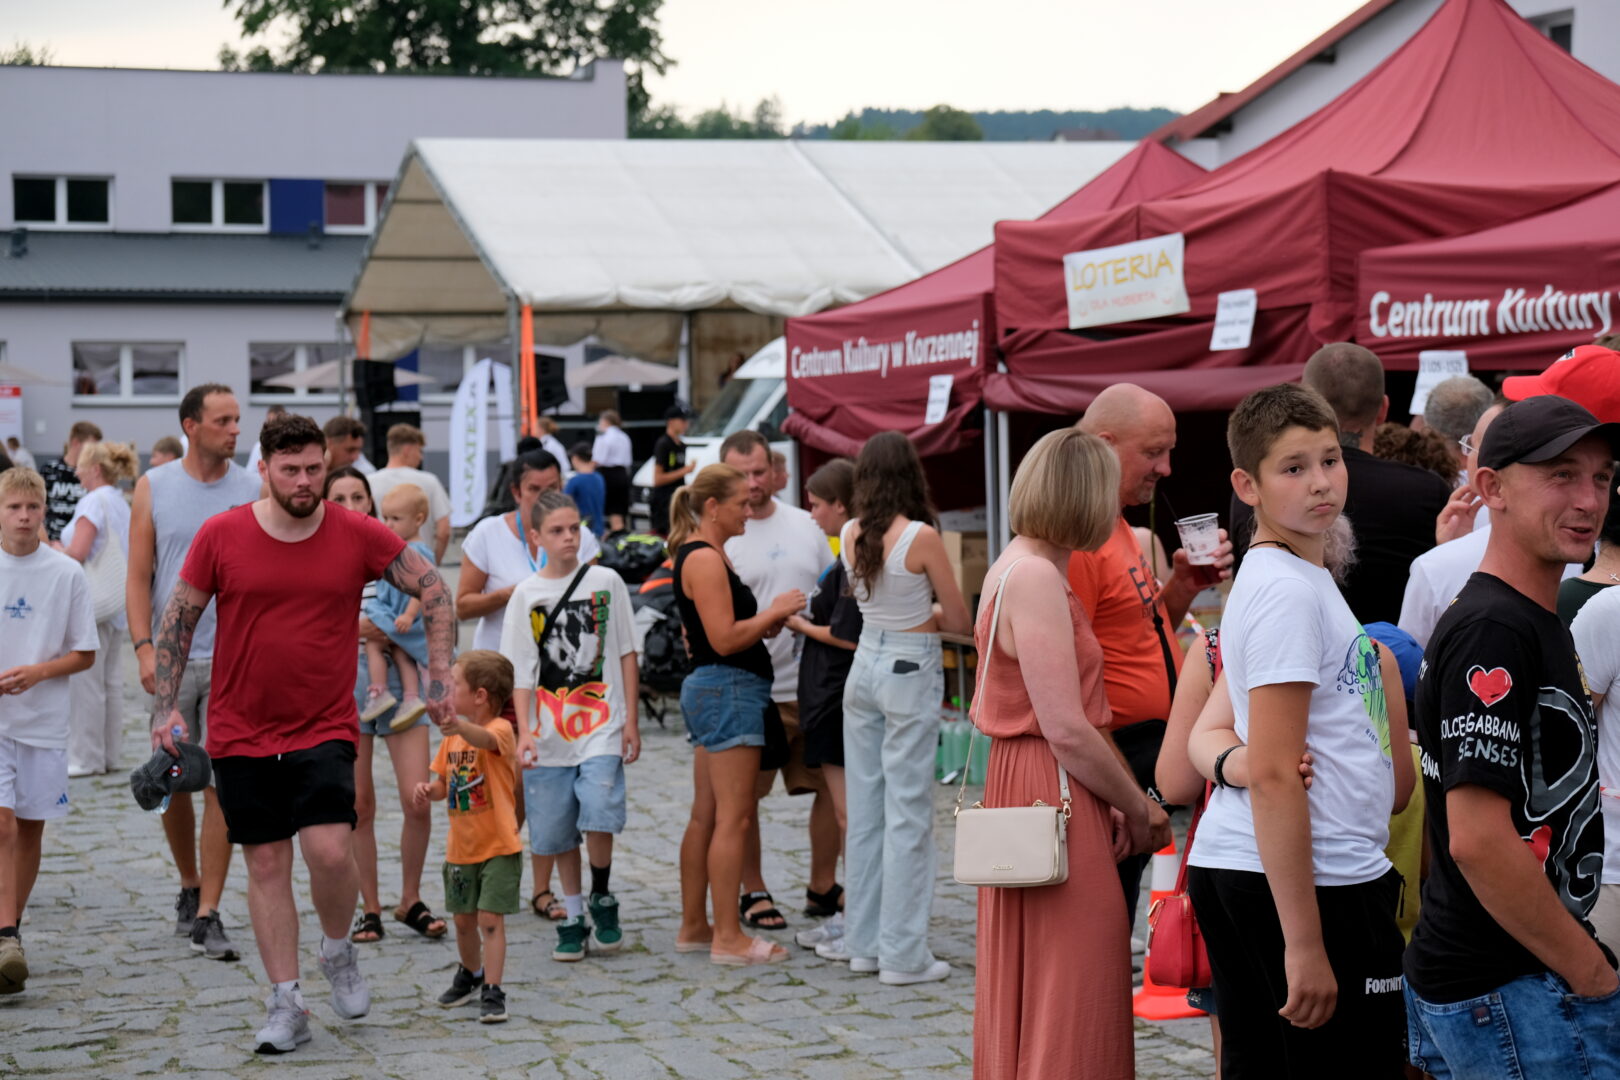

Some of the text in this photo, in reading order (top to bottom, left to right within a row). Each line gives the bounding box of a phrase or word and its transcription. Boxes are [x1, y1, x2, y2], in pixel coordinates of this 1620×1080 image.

[1072, 249, 1174, 291] LOTERIA
[1370, 284, 1612, 338] Centrum Kultury
[791, 319, 979, 379] Centrum Kultury w Korzennej
[1441, 712, 1521, 744] OLCEGABBANA
[1458, 736, 1519, 768] SENSES
[1365, 976, 1403, 995] FORTNIT
